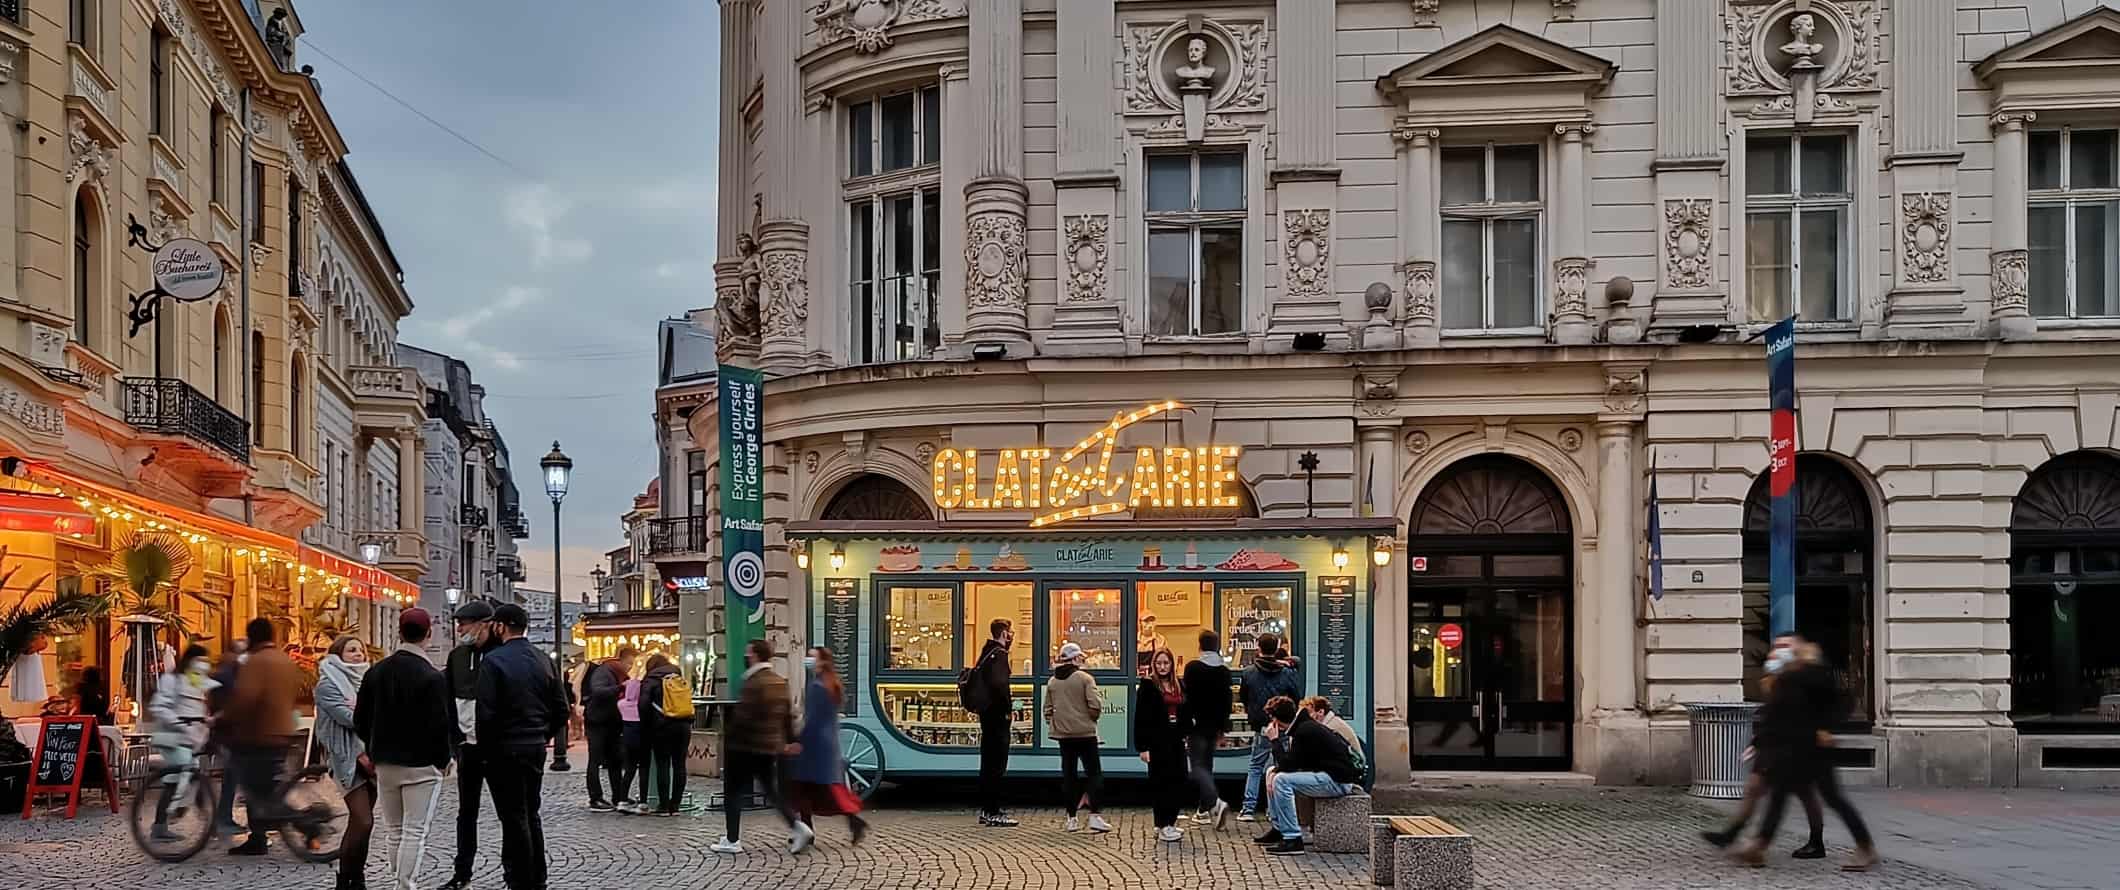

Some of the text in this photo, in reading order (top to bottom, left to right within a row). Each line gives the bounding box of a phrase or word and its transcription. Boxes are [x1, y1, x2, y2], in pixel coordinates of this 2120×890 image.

[171, 249, 201, 264] Little
[155, 260, 212, 276] Bucharest
[743, 383, 756, 430] Circles
[728, 379, 744, 500] Express yourself
[745, 433, 759, 486] George
[934, 448, 1050, 508] CLAT
[1128, 447, 1241, 508] ARIE
[724, 517, 740, 530] Art
[1056, 549, 1077, 561] CLAT
[1094, 548, 1113, 561] ARIE
[1228, 604, 1283, 621] Collect your
